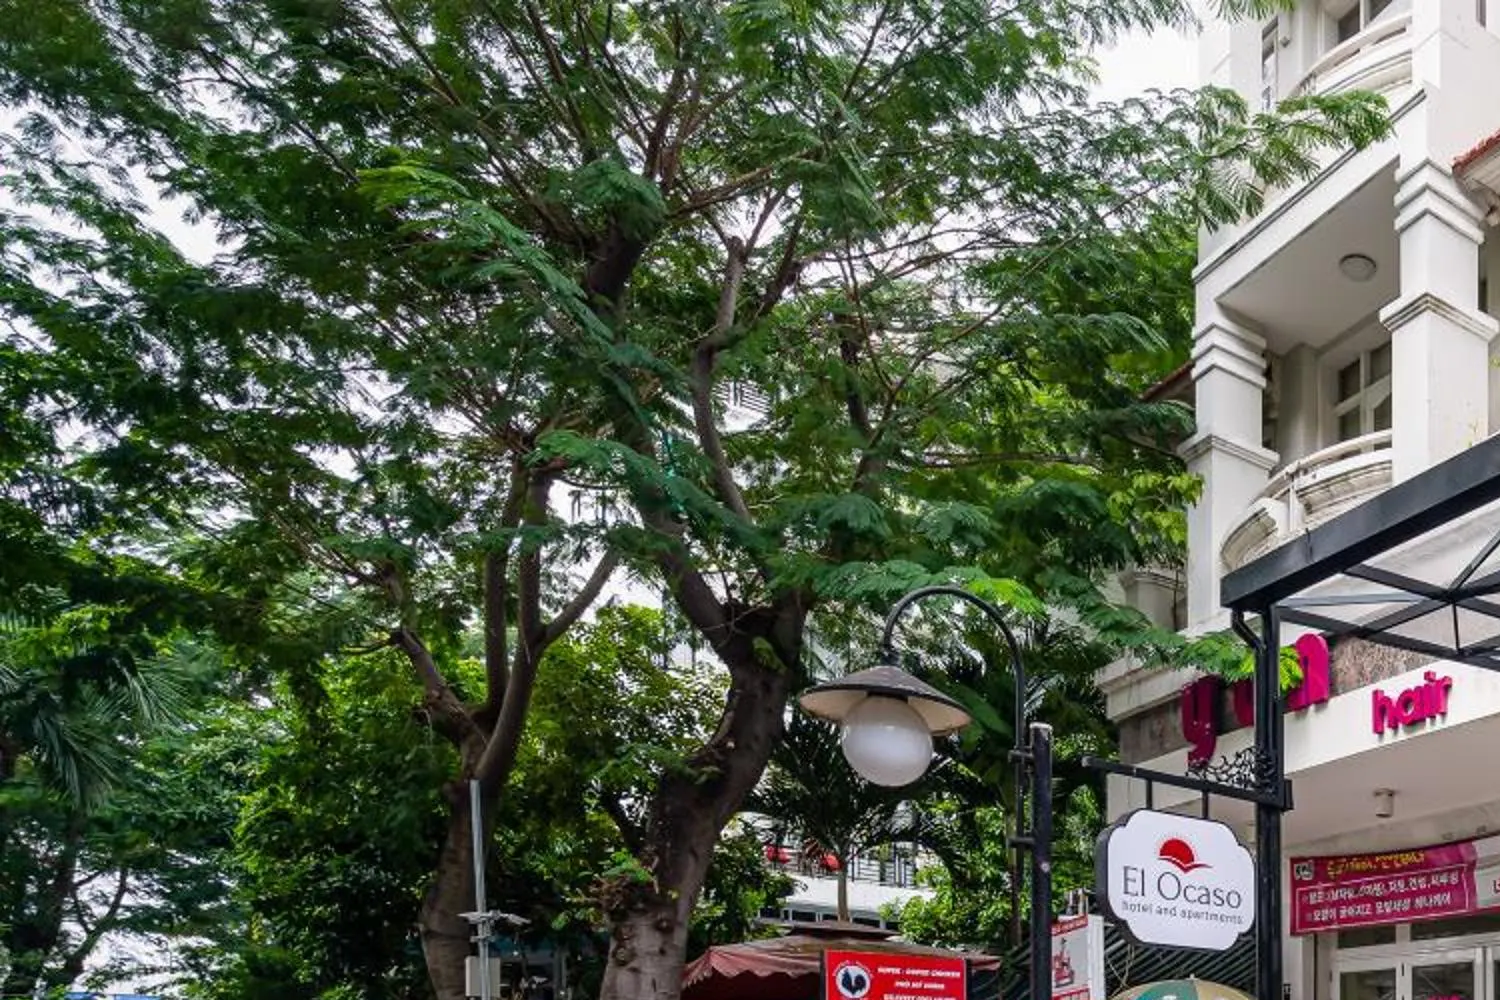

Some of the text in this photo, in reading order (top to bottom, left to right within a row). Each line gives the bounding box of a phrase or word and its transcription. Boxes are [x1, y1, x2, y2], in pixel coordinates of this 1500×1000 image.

[1372, 670, 1453, 735] hair
[1122, 865, 1242, 909] El Ocaso
[1121, 900, 1244, 925] hotel and apartments
